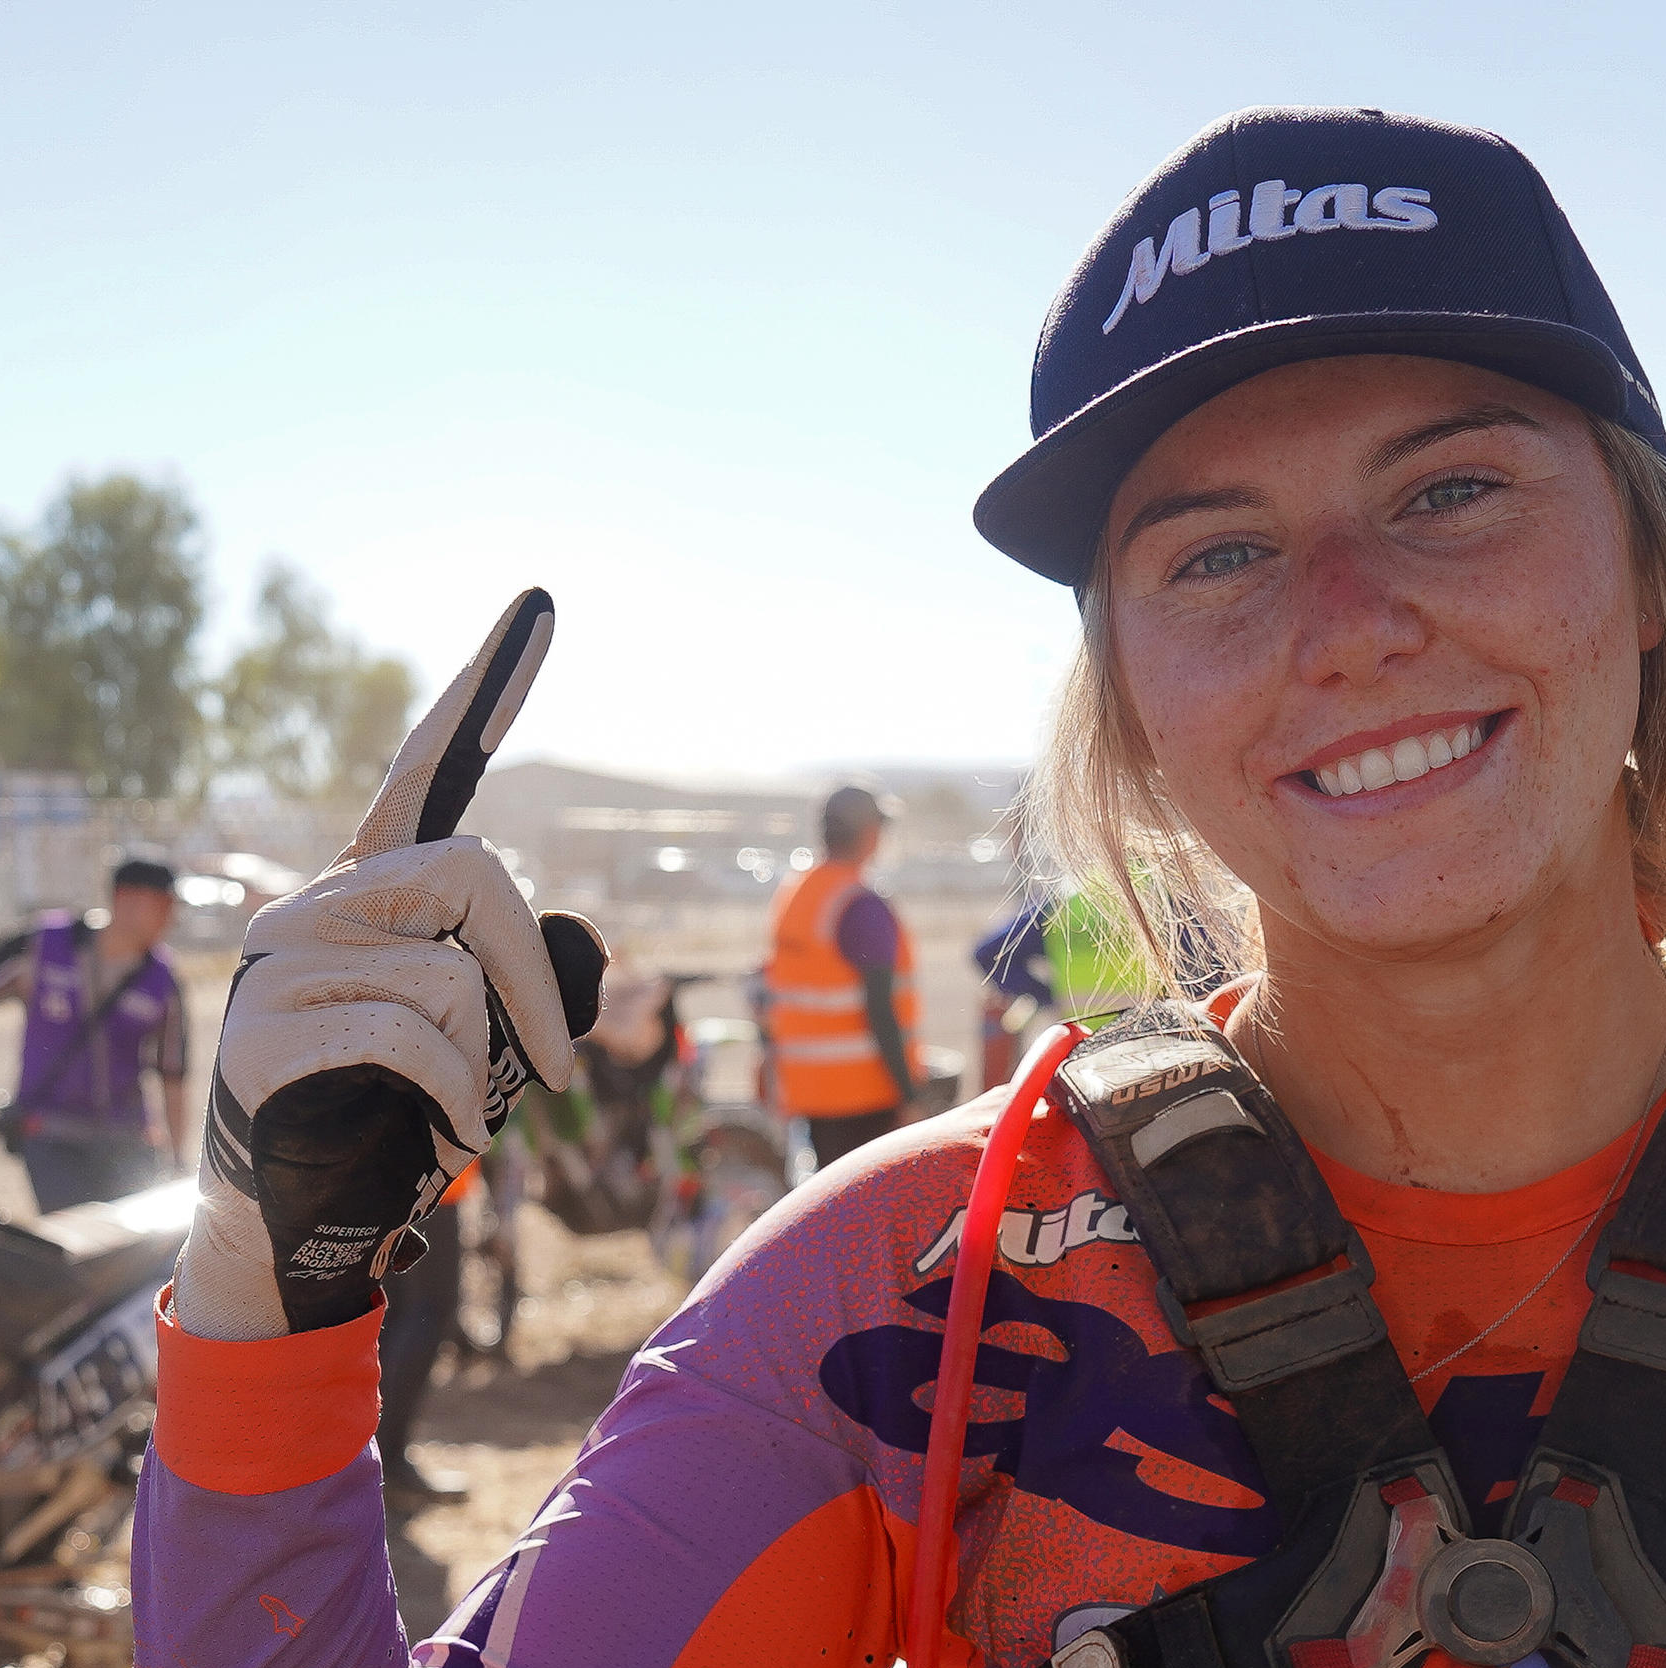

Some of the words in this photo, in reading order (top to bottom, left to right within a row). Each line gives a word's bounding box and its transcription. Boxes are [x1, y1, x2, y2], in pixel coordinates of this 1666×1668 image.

[1102, 180, 1439, 335] Mitas
[315, 1224, 381, 1237] SUPERTECH
[916, 1193, 1140, 1273] Mita
[304, 1238, 376, 1252] ALPINESTARS
[297, 1246, 333, 1260] RACE
